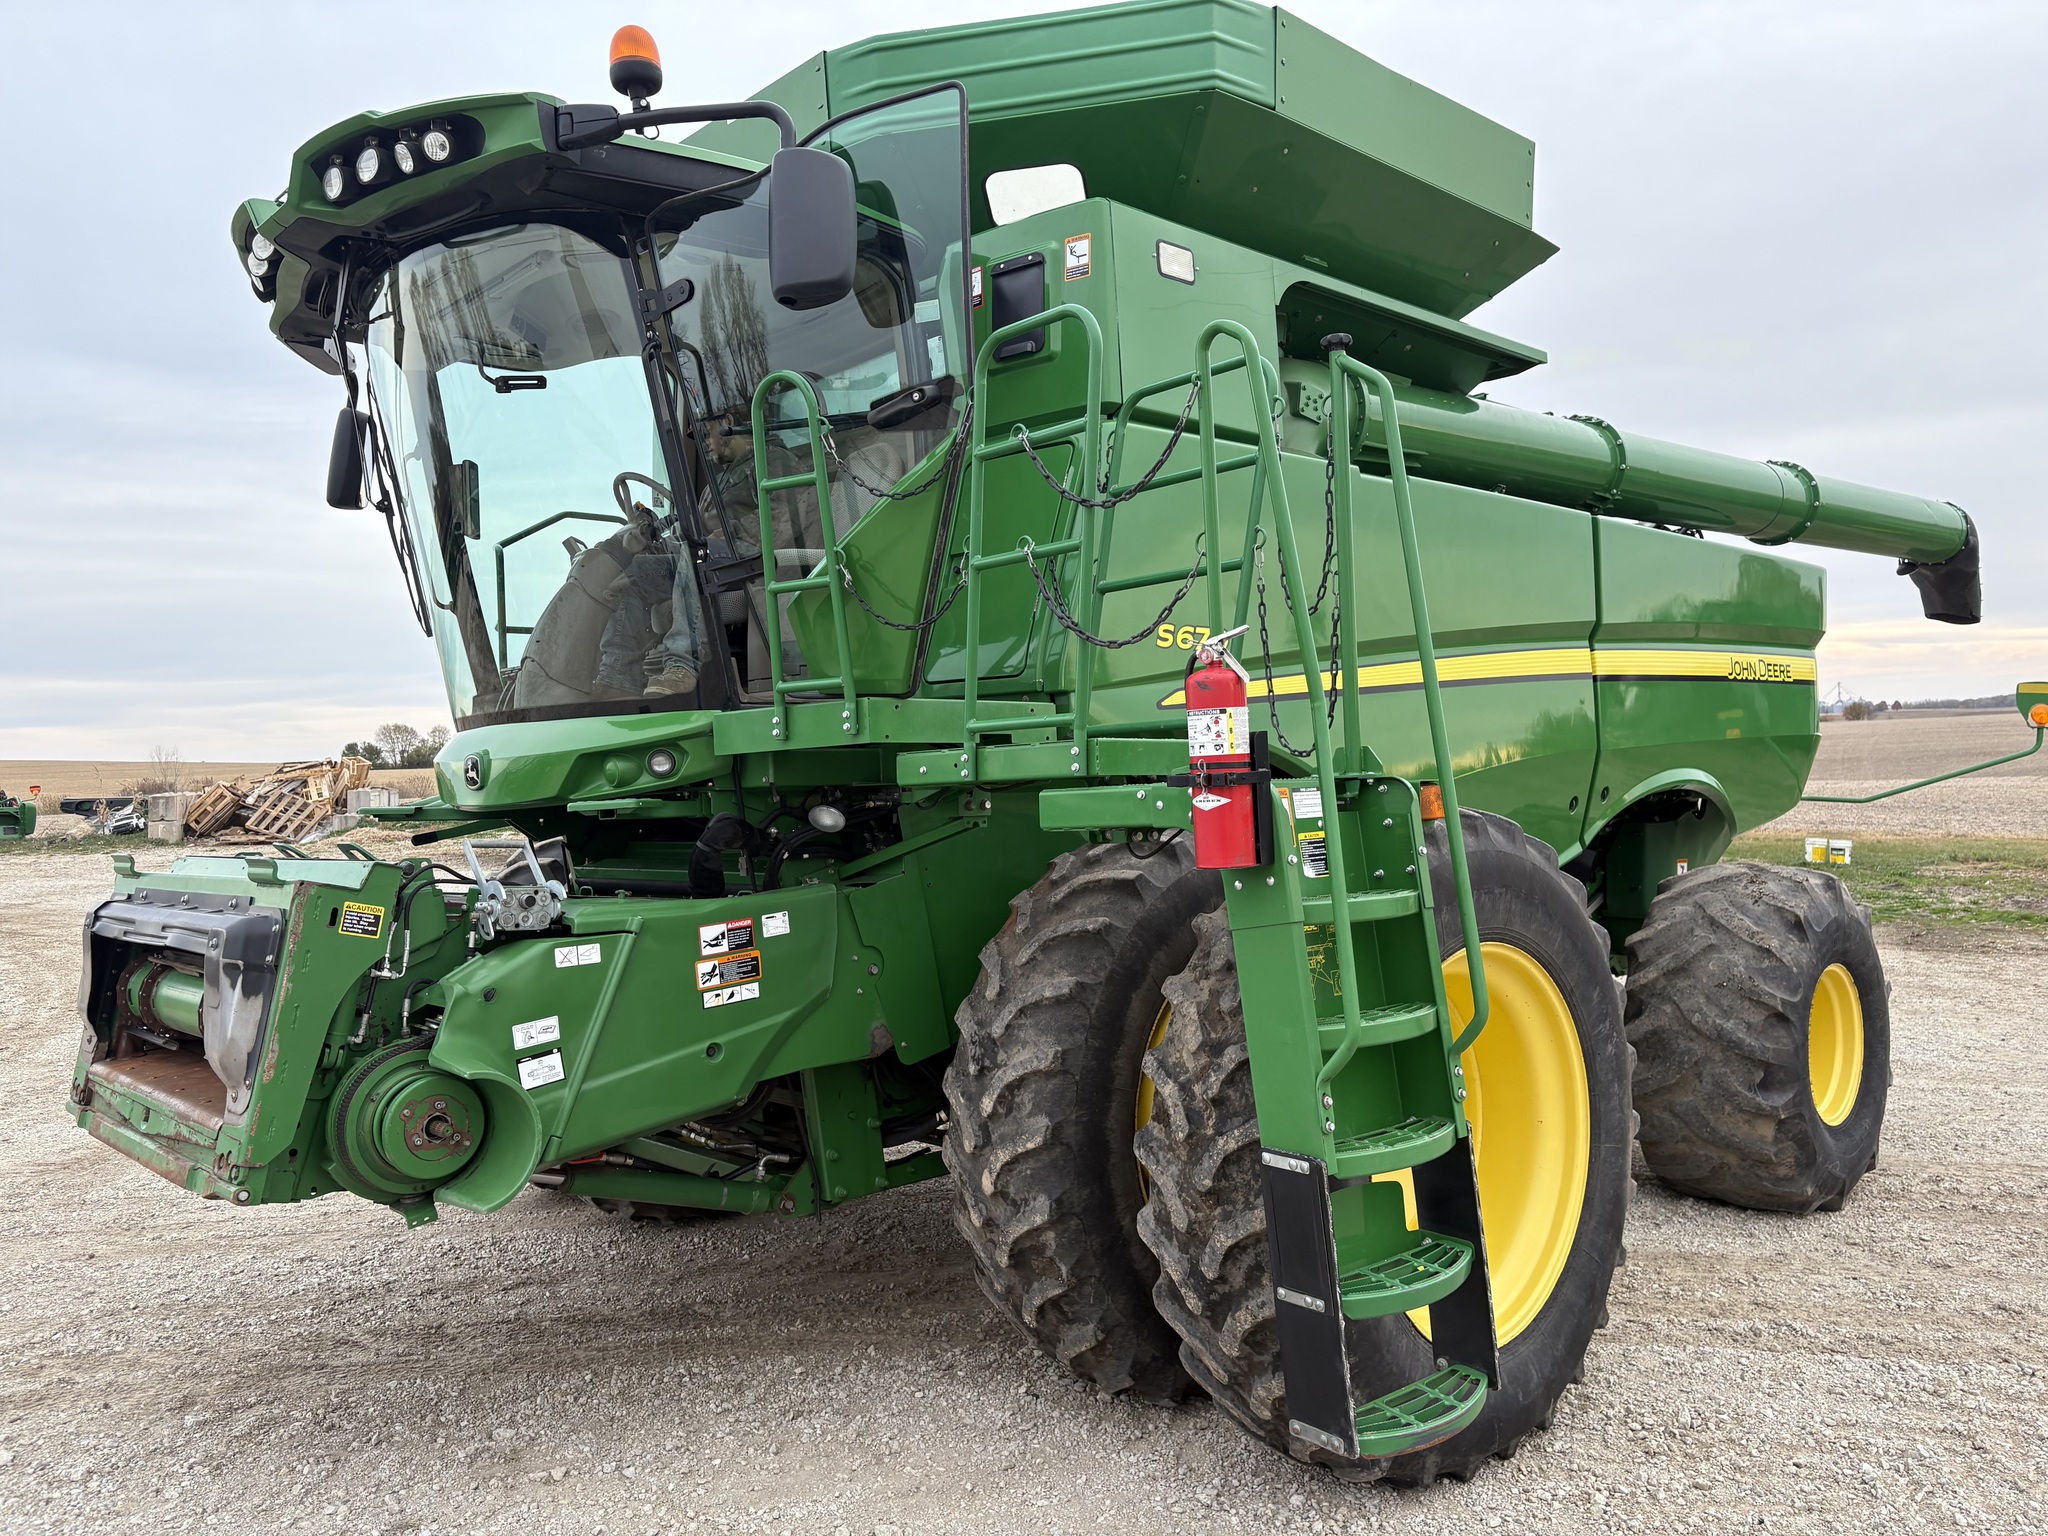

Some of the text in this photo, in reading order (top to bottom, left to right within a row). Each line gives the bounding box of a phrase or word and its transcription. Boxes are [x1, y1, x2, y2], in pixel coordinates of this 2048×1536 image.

[1156, 623, 1229, 651] S67
[1728, 656, 1792, 679] JOHN DEERE
[351, 904, 383, 914] CAUTION
[731, 919, 752, 927] DANGER
